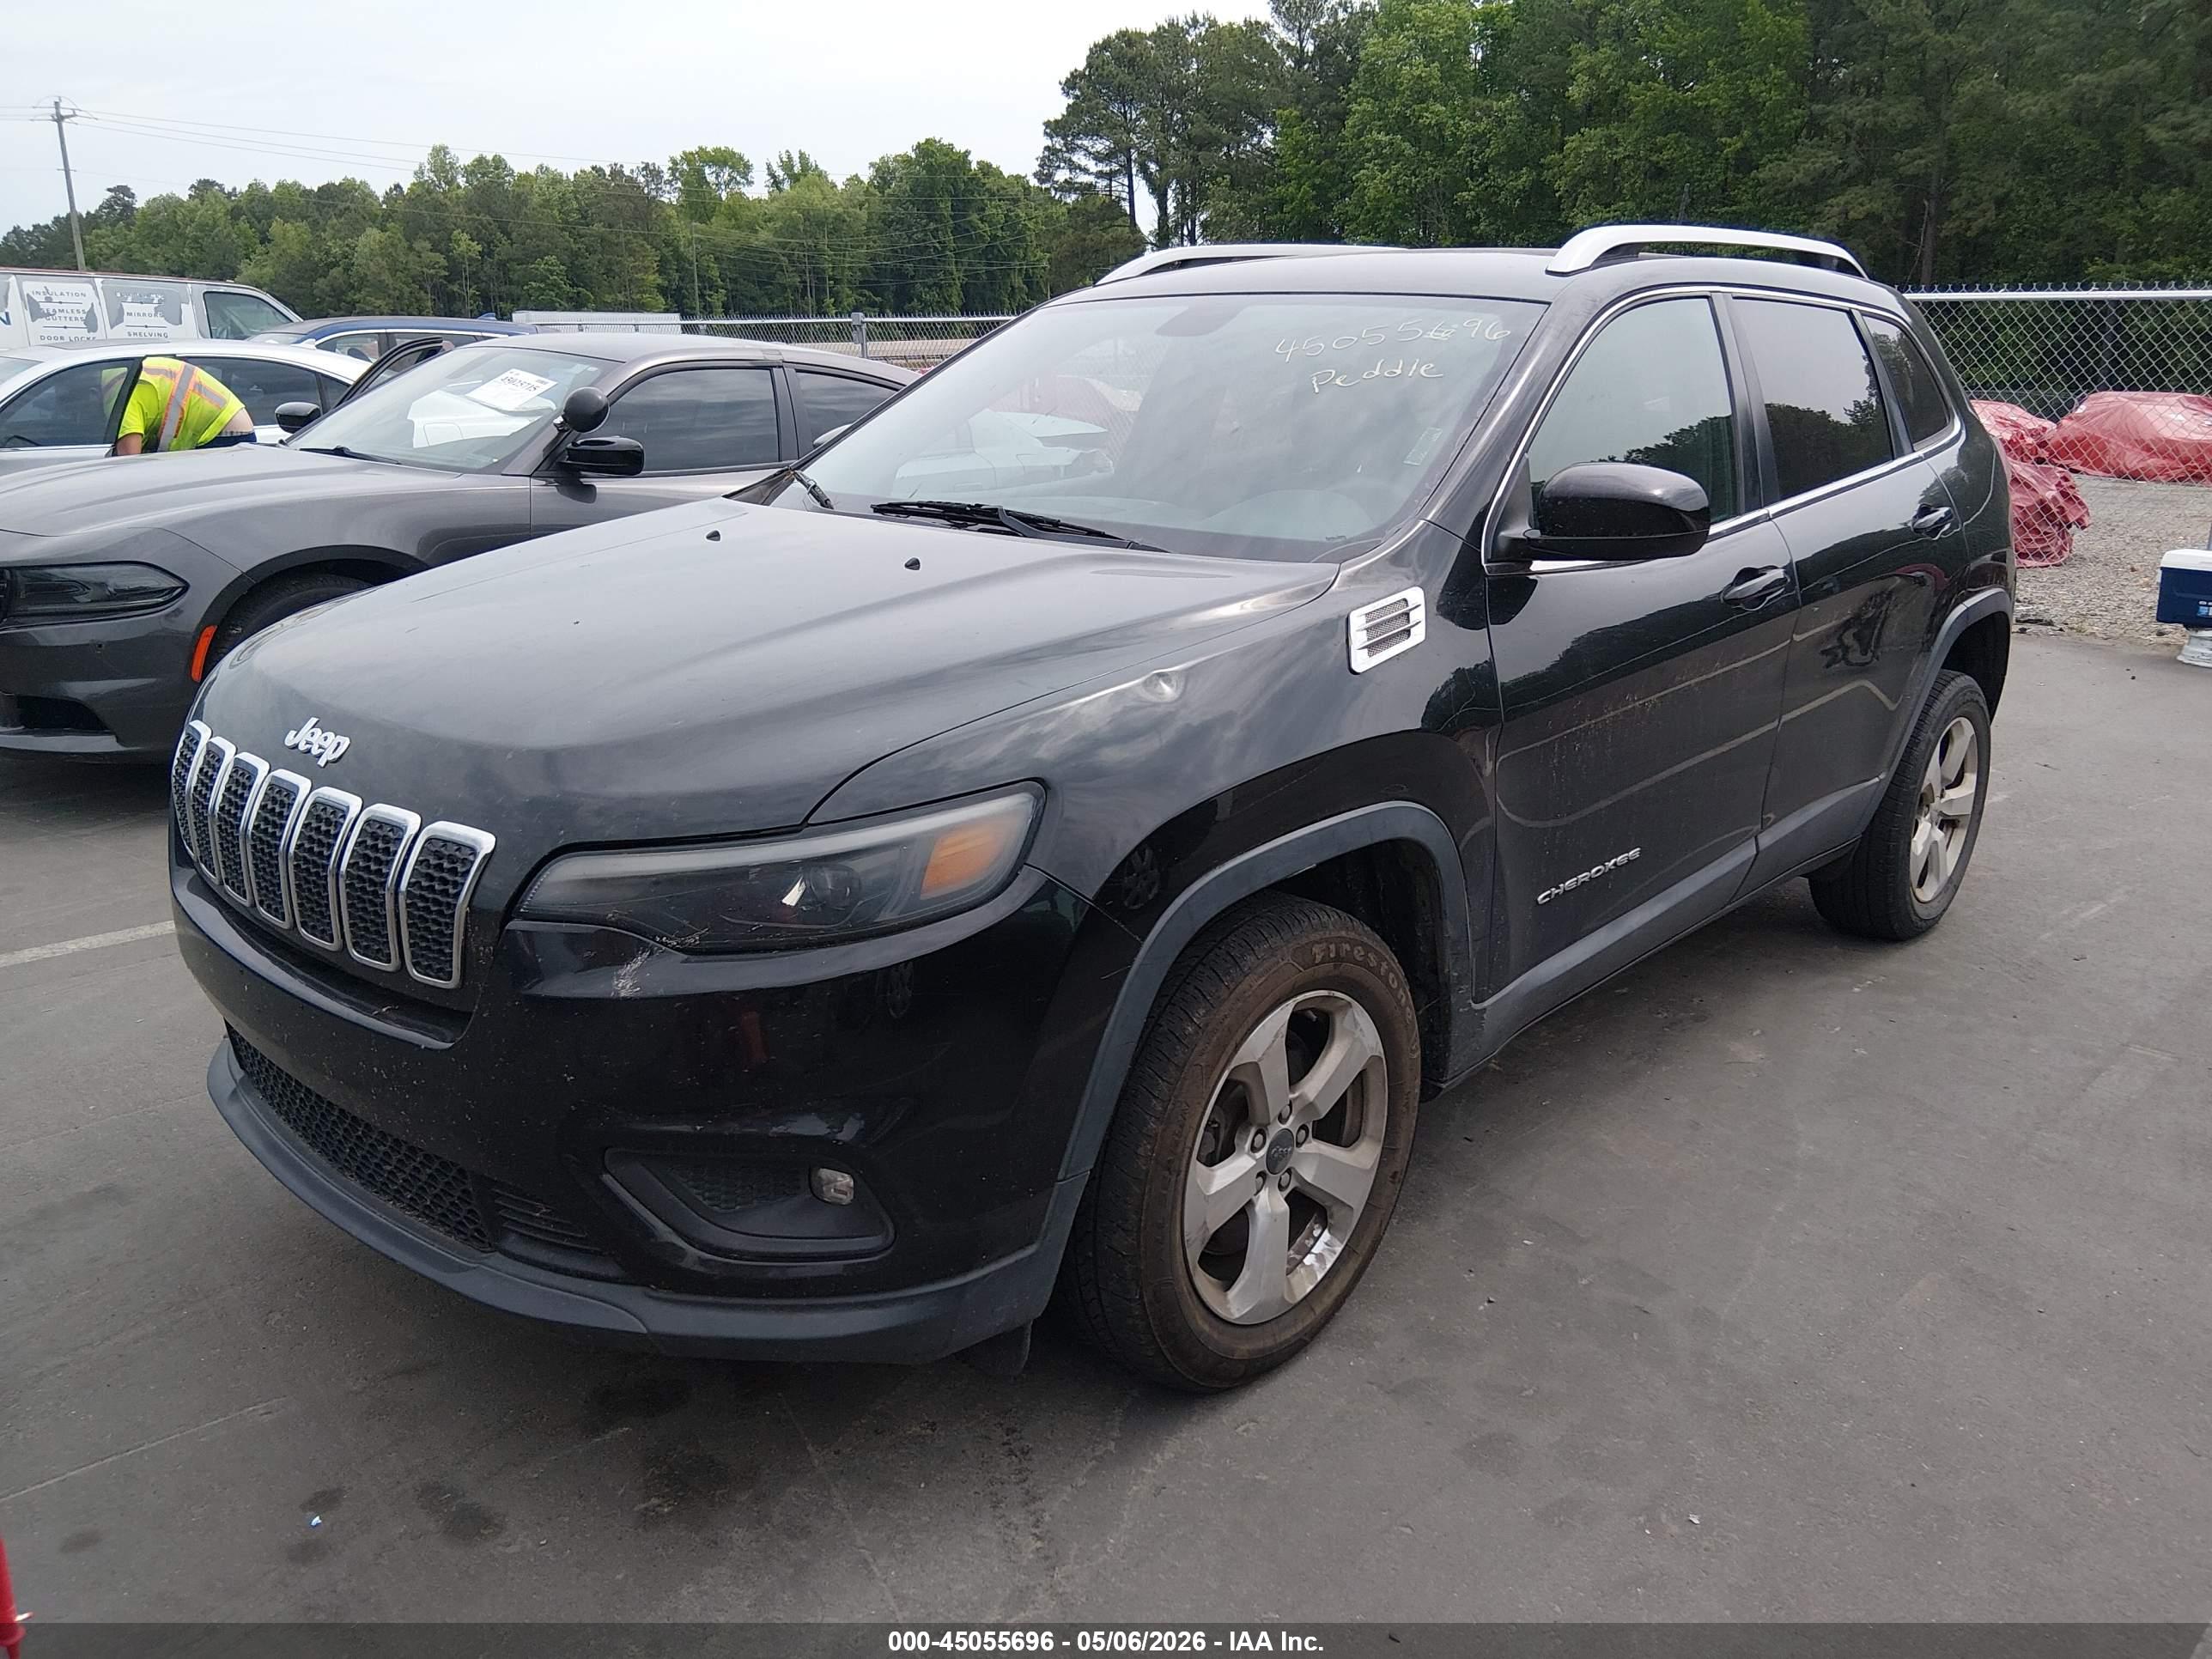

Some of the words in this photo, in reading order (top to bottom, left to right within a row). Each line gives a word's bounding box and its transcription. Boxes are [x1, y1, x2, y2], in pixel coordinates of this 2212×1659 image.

[1310, 358, 1443, 394] Peddle
[284, 717, 350, 768] Jeep
[1536, 847, 1642, 905] CHEROKEE
